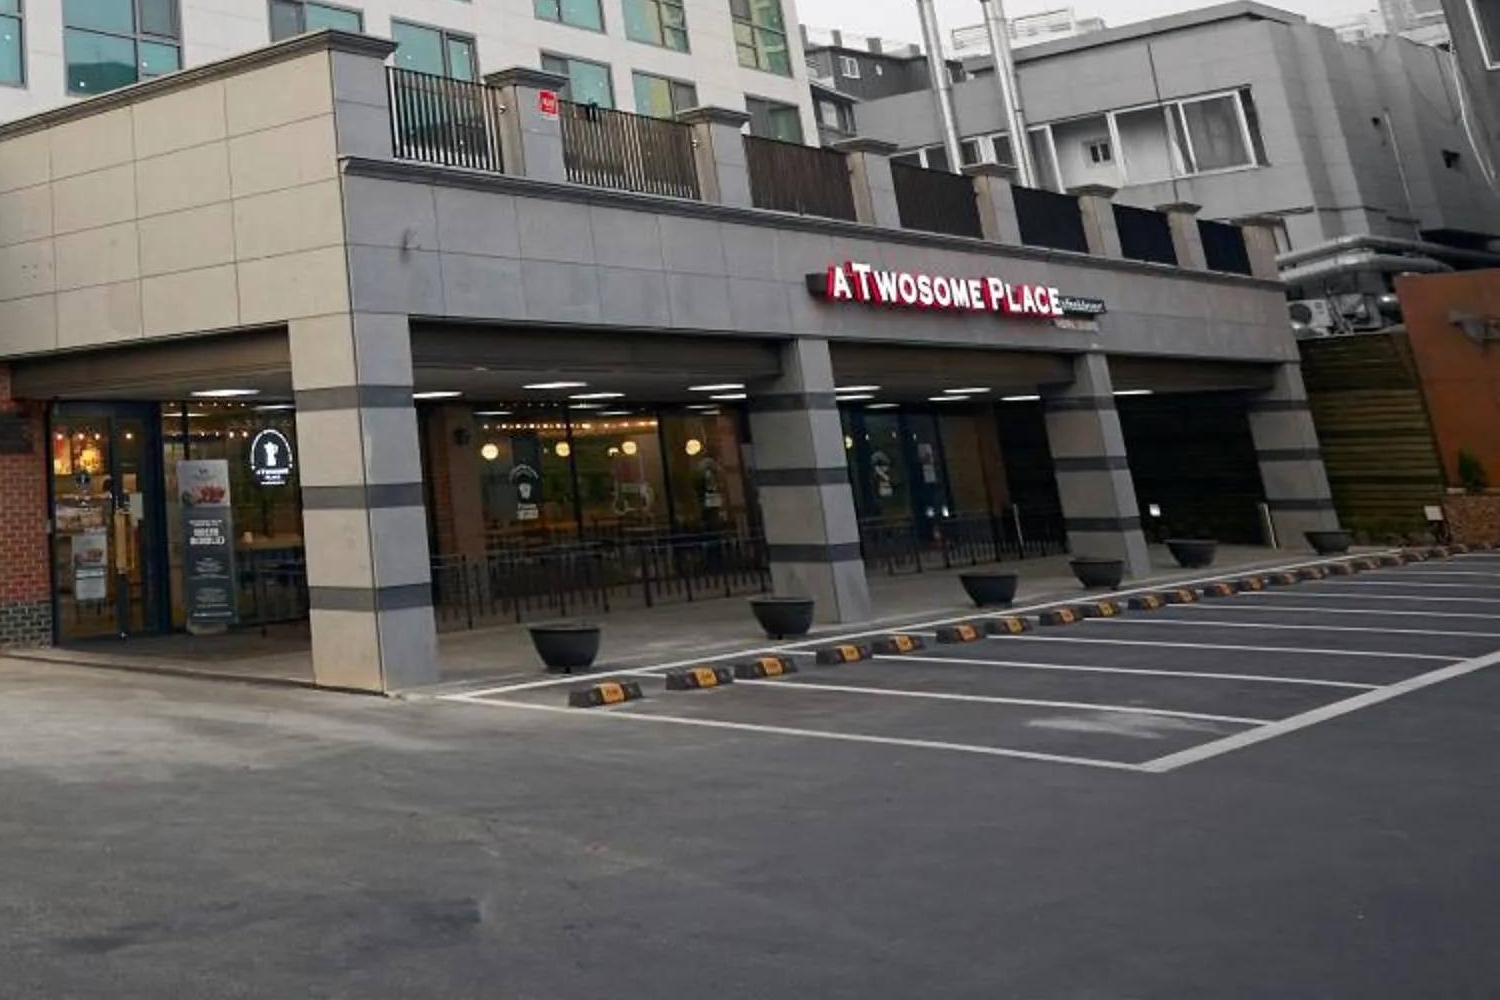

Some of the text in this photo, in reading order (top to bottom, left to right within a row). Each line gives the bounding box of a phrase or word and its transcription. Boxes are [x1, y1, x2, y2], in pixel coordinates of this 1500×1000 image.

[831, 262, 1064, 316] A TWOSOME PLACE
